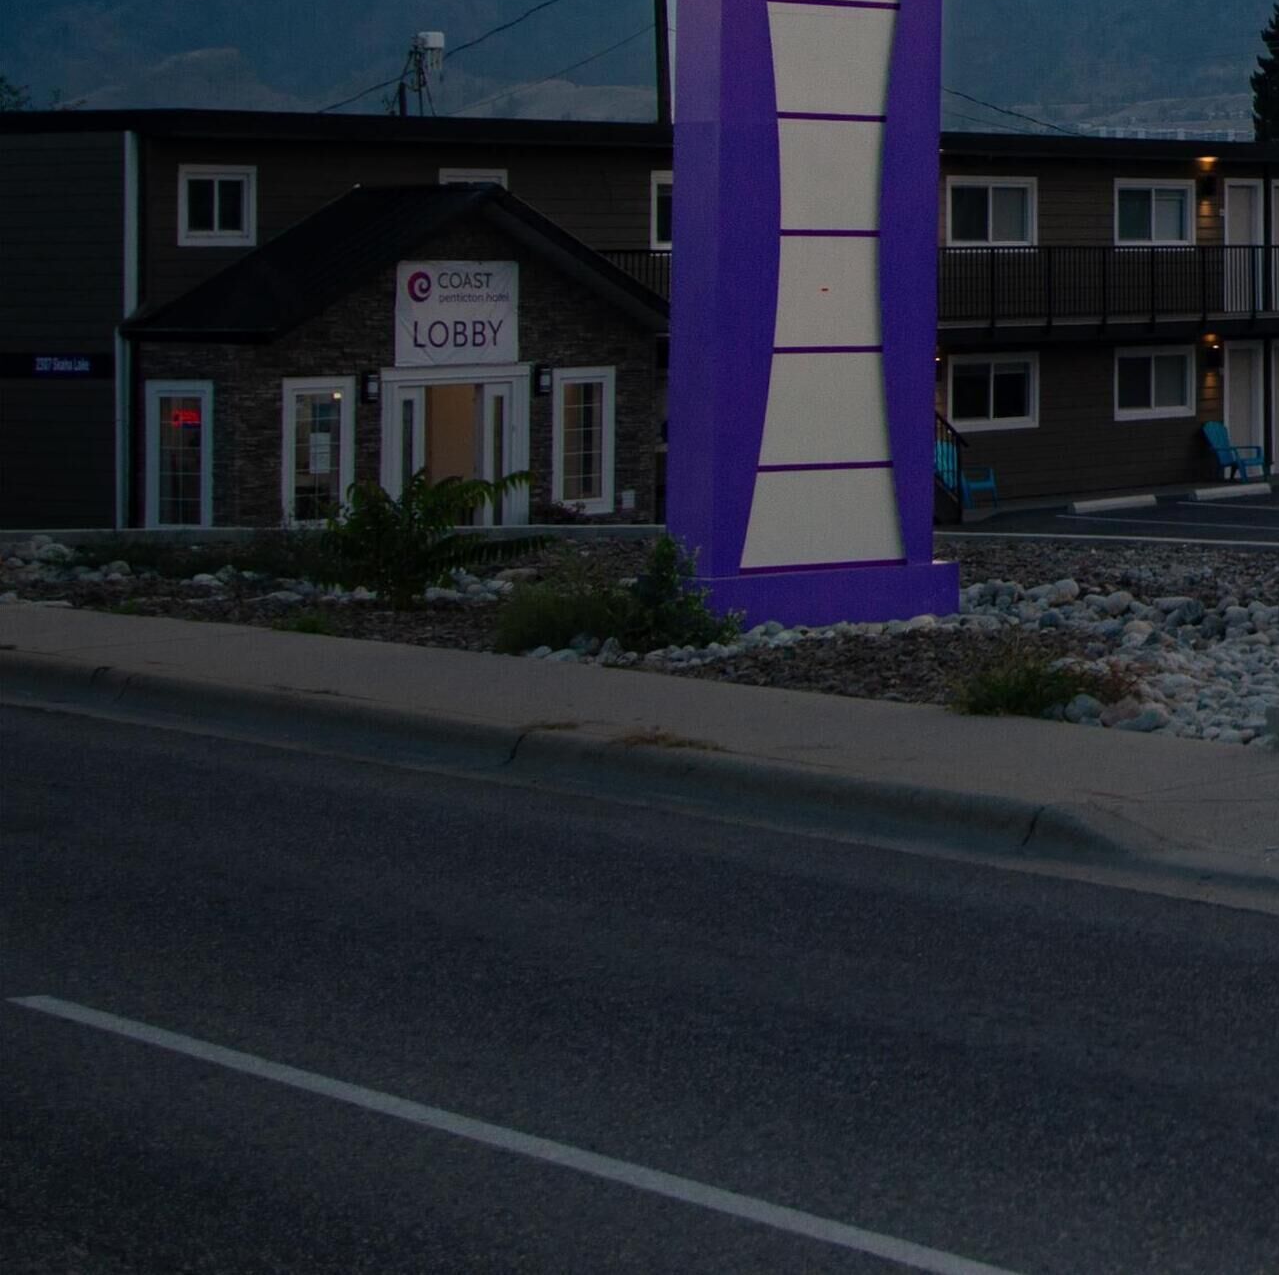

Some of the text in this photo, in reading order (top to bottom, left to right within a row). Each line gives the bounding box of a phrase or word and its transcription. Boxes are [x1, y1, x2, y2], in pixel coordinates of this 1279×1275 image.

[438, 272, 493, 289] COAST
[439, 292, 484, 303] penticton
[413, 319, 503, 348] LOBBY
